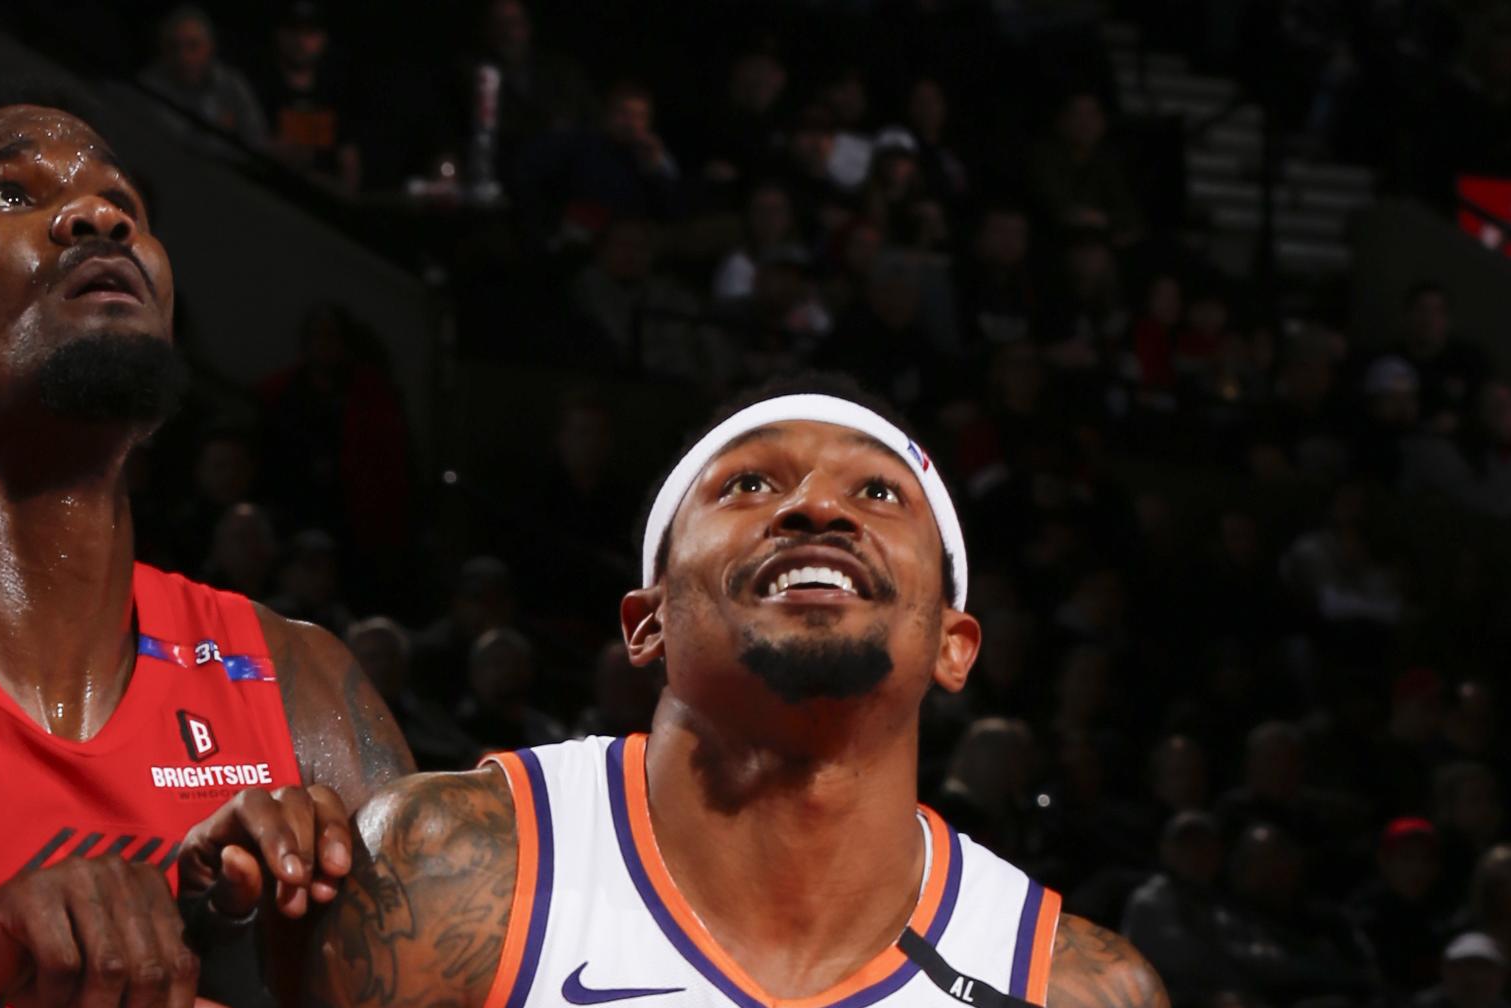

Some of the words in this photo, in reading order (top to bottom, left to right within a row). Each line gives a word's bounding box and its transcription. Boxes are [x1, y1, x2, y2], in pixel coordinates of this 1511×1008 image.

[189, 719, 212, 753] B
[151, 763, 272, 788] BRIGHTSIDE
[179, 788, 239, 801] WINDO
[950, 976, 975, 1003] AL
